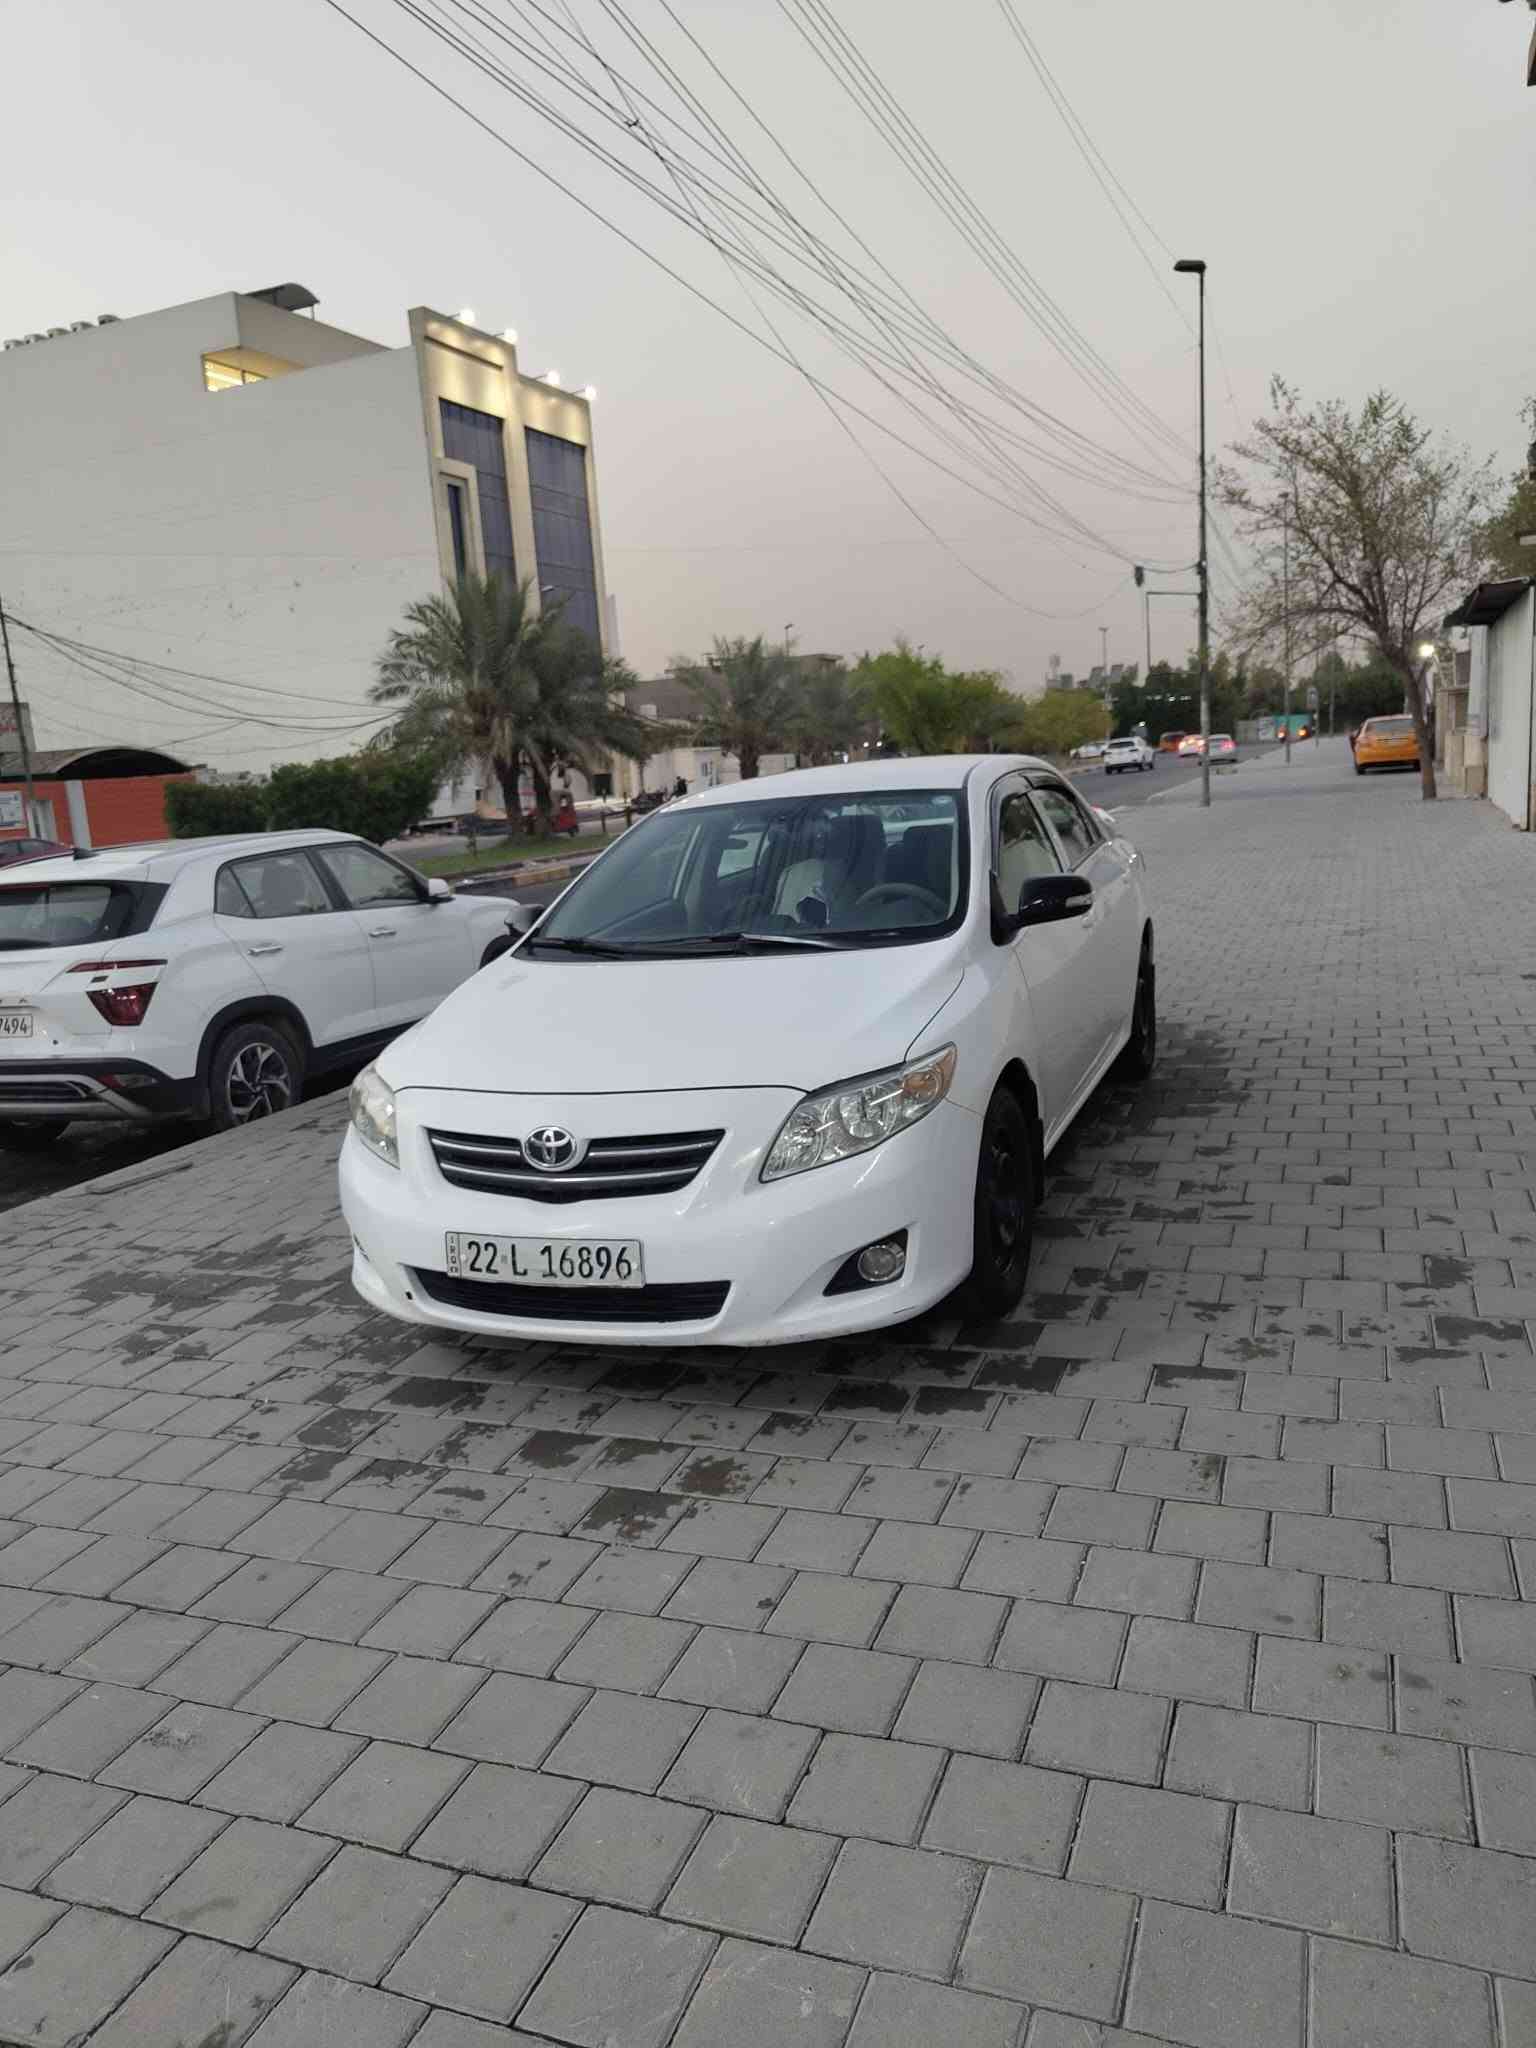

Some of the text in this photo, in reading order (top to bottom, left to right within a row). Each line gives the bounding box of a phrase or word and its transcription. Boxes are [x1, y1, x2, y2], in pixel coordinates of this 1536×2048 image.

[468, 1240, 632, 1279] 22 L 16896
